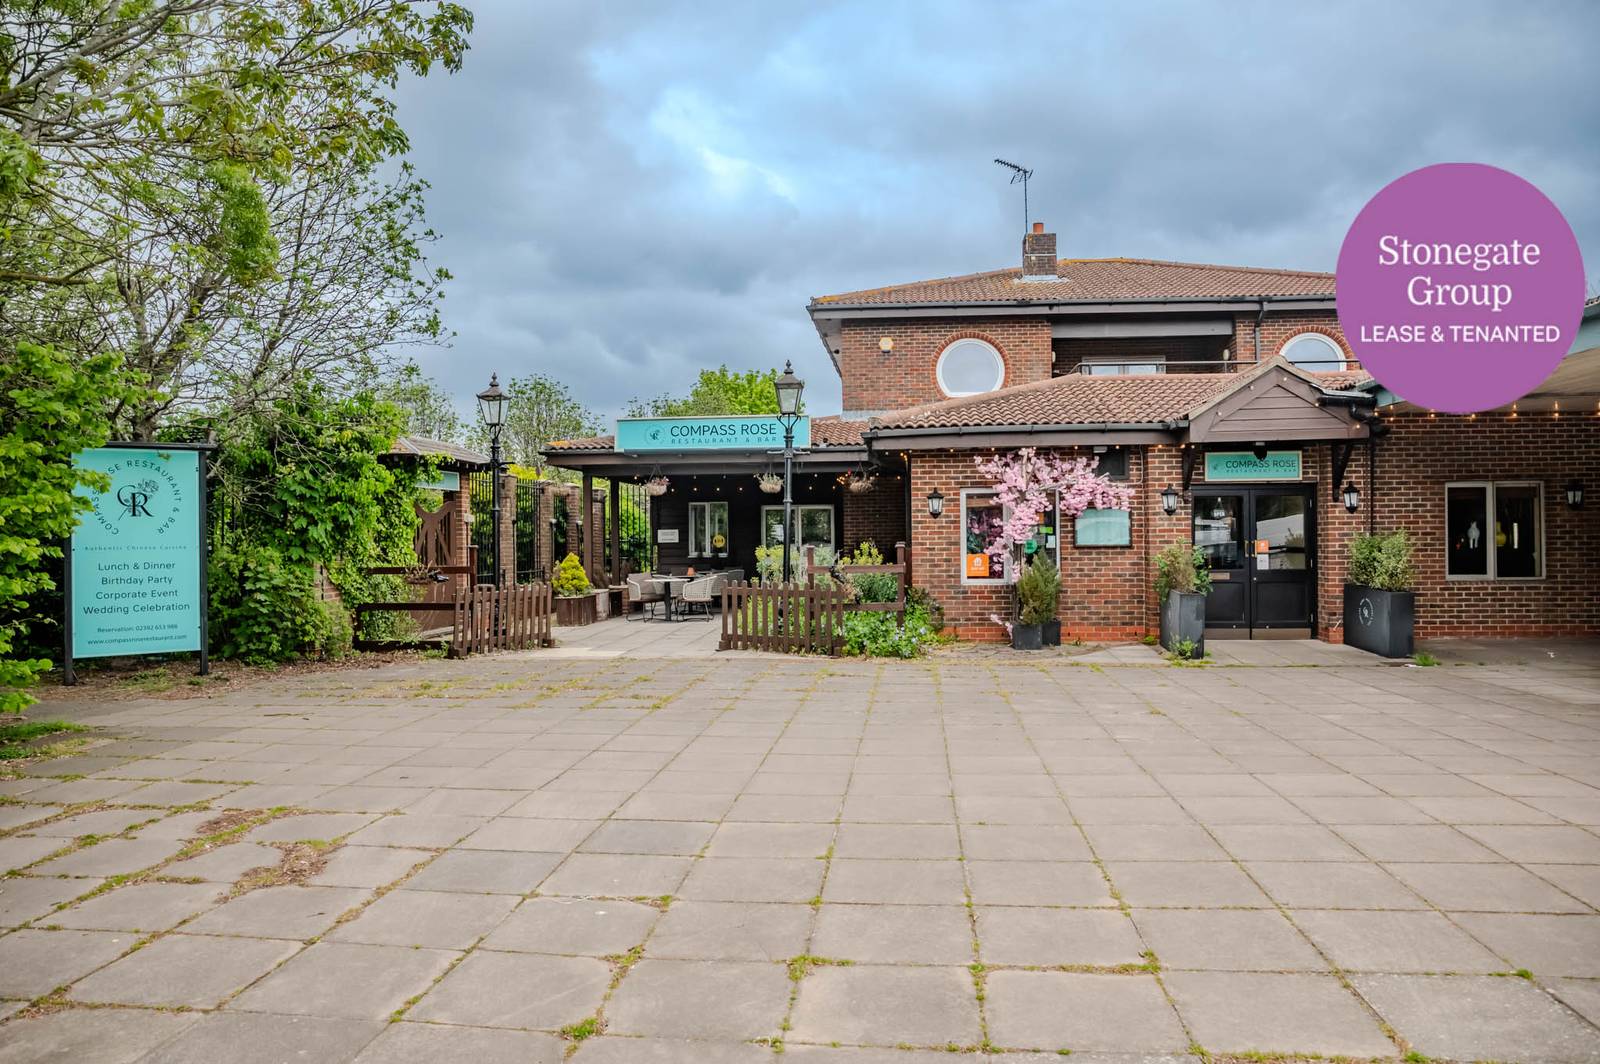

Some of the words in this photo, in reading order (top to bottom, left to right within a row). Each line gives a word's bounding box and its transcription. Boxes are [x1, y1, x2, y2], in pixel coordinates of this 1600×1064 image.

[670, 424, 736, 437] COMPASS
[741, 423, 777, 435] ROSE
[671, 437, 738, 445] RESTAURANT
[1225, 460, 1270, 469] COMPASS
[1272, 459, 1297, 468] ROSE
[126, 460, 182, 502] RESTAURANT
[158, 517, 176, 534] BAR
[98, 562, 130, 571] Lunch
[132, 562, 140, 570] &
[143, 562, 176, 570] Dinner
[101, 576, 144, 586] Birthday
[147, 576, 173, 585] Party
[95, 590, 148, 601] Corporate
[151, 589, 178, 598] Event
[82, 605, 130, 615] Wedding
[132, 603, 190, 613] Celebration
